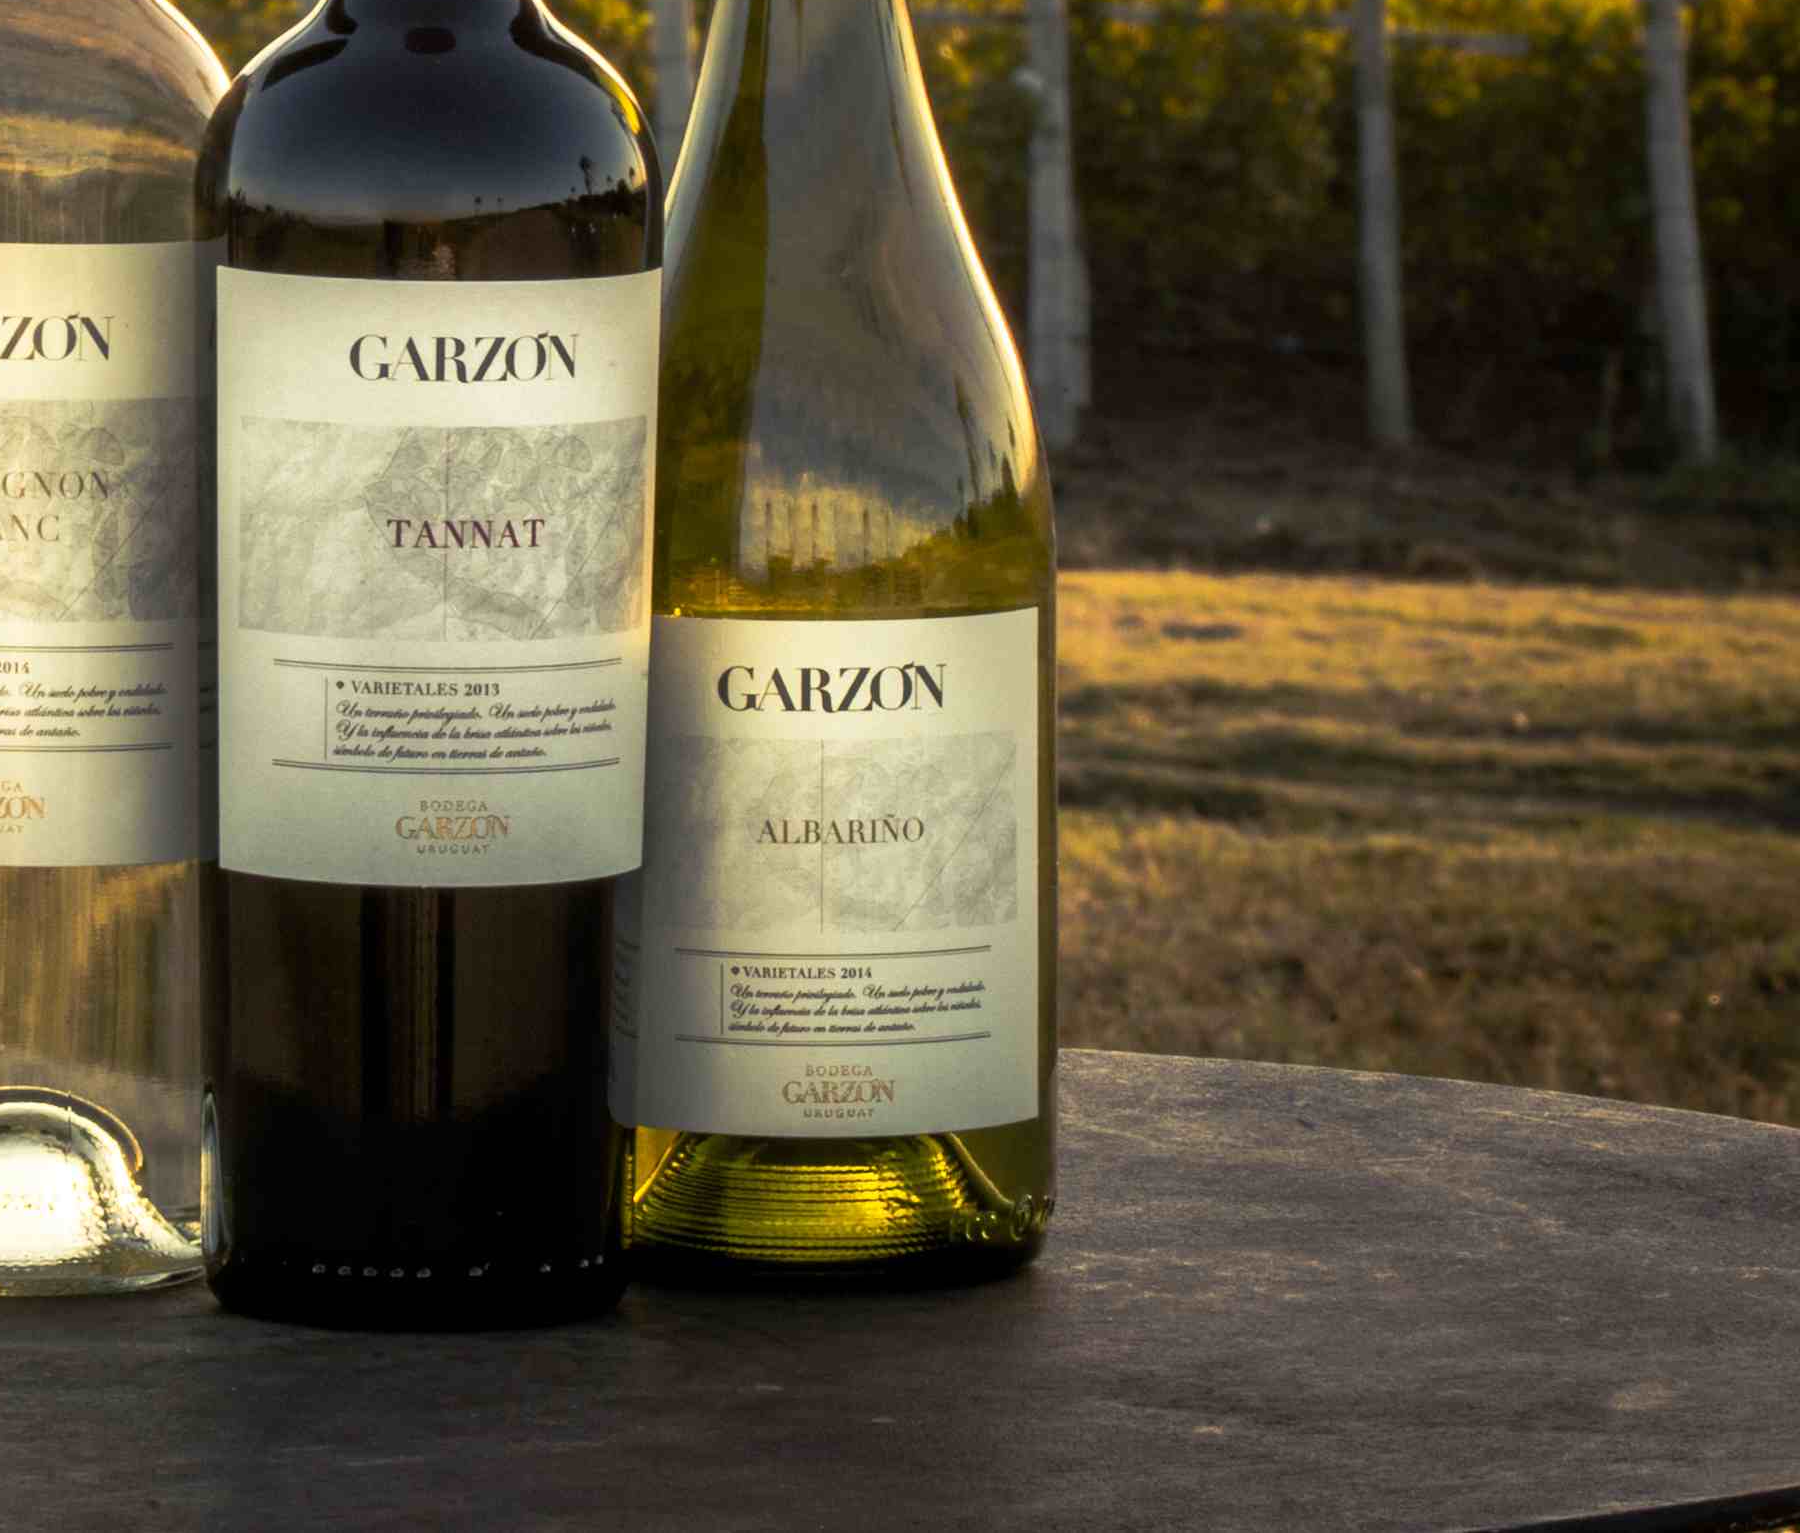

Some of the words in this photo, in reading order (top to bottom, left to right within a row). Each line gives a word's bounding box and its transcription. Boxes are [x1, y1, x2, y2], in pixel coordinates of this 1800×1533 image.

[349, 331, 580, 384] GARZÓN
[386, 518, 545, 549] TANNAT
[351, 680, 458, 696] VARIETALES
[464, 683, 500, 696] 2013
[717, 661, 947, 713] GARZÓN
[419, 800, 488, 812] BODEGA
[757, 814, 924, 844] ALBARIÑO
[743, 966, 836, 979] VARIETALES
[841, 967, 872, 979] 2014
[805, 1063, 873, 1076] BODEGA
